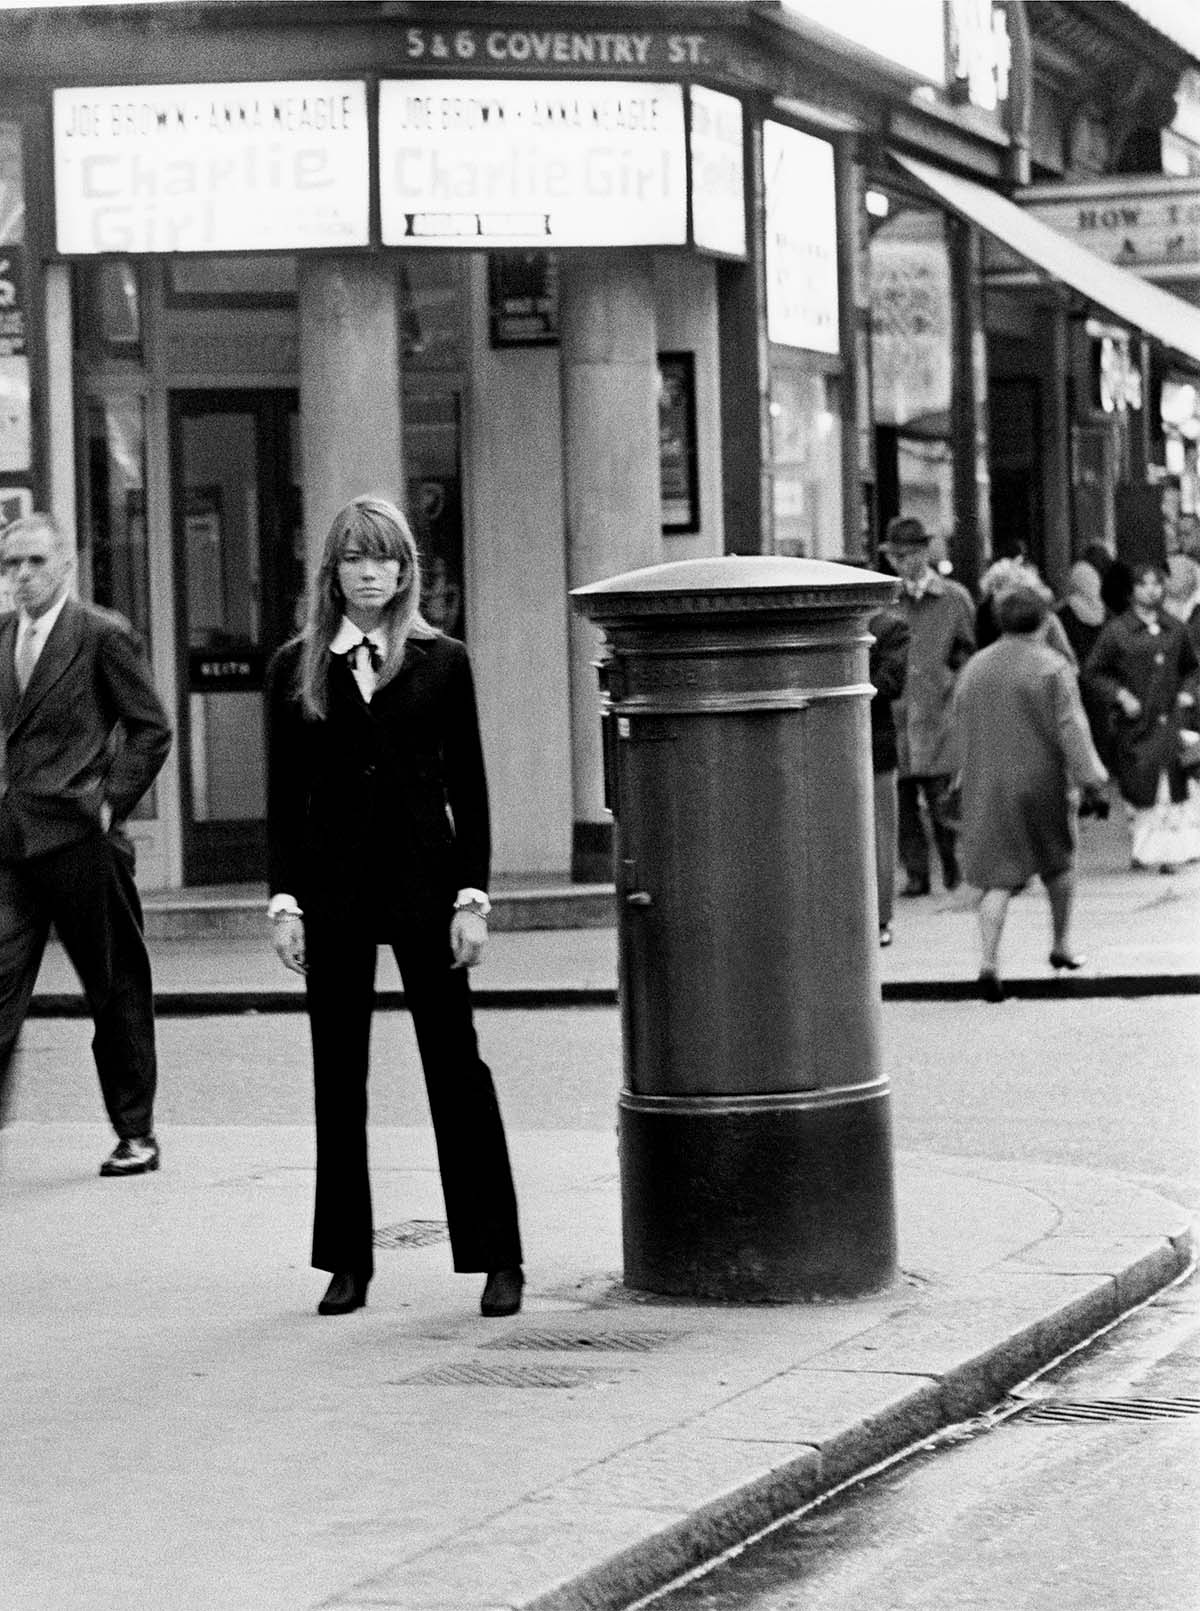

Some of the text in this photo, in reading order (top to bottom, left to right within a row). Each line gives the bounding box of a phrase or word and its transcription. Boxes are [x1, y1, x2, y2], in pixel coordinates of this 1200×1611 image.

[407, 27, 711, 64] 5 & 6 COVENTRY ST.
[111, 102, 188, 136] BROWN
[209, 99, 263, 130] ANNA
[271, 95, 352, 131] NEAGLE
[80, 142, 336, 199] Charlie
[394, 144, 570, 200] Charlie
[583, 146, 673, 201] Girl
[90, 202, 215, 250] Girl
[1079, 208, 1139, 229] HOW
